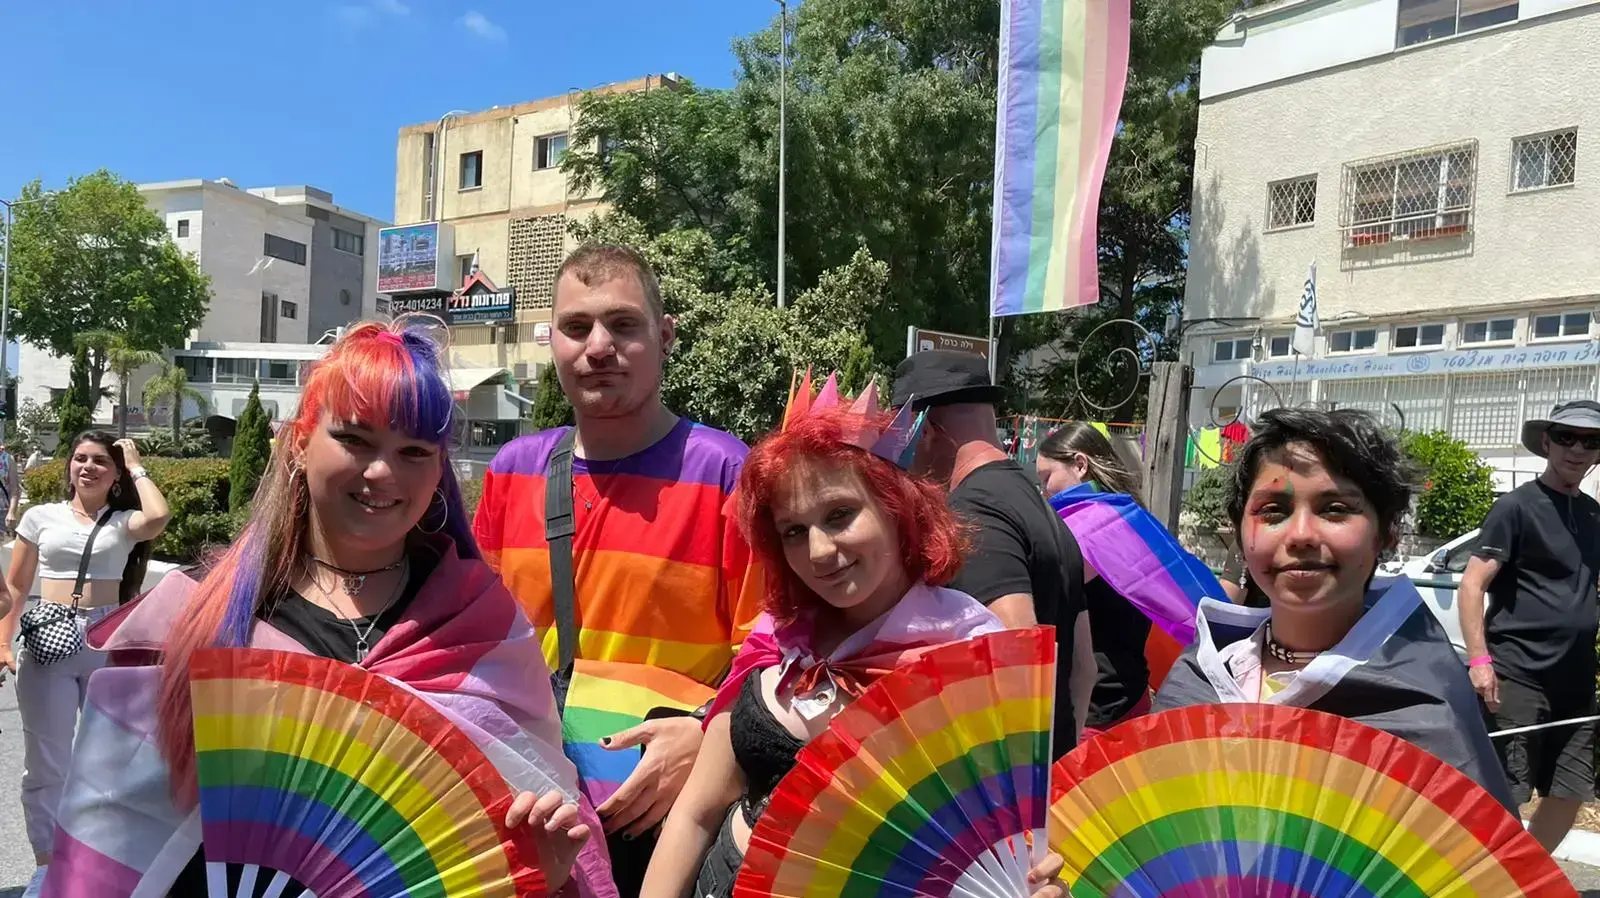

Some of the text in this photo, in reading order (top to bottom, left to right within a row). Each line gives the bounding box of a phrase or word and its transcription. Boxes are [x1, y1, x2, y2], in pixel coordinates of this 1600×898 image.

[388, 298, 442, 312] 077-4014234
[472, 293, 510, 307] פתרונות
[940, 336, 974, 349] וילה כרמל
[1501, 353, 1527, 365] בית
[1532, 350, 1566, 363] חיפה
[1276, 365, 1301, 376] Haia
